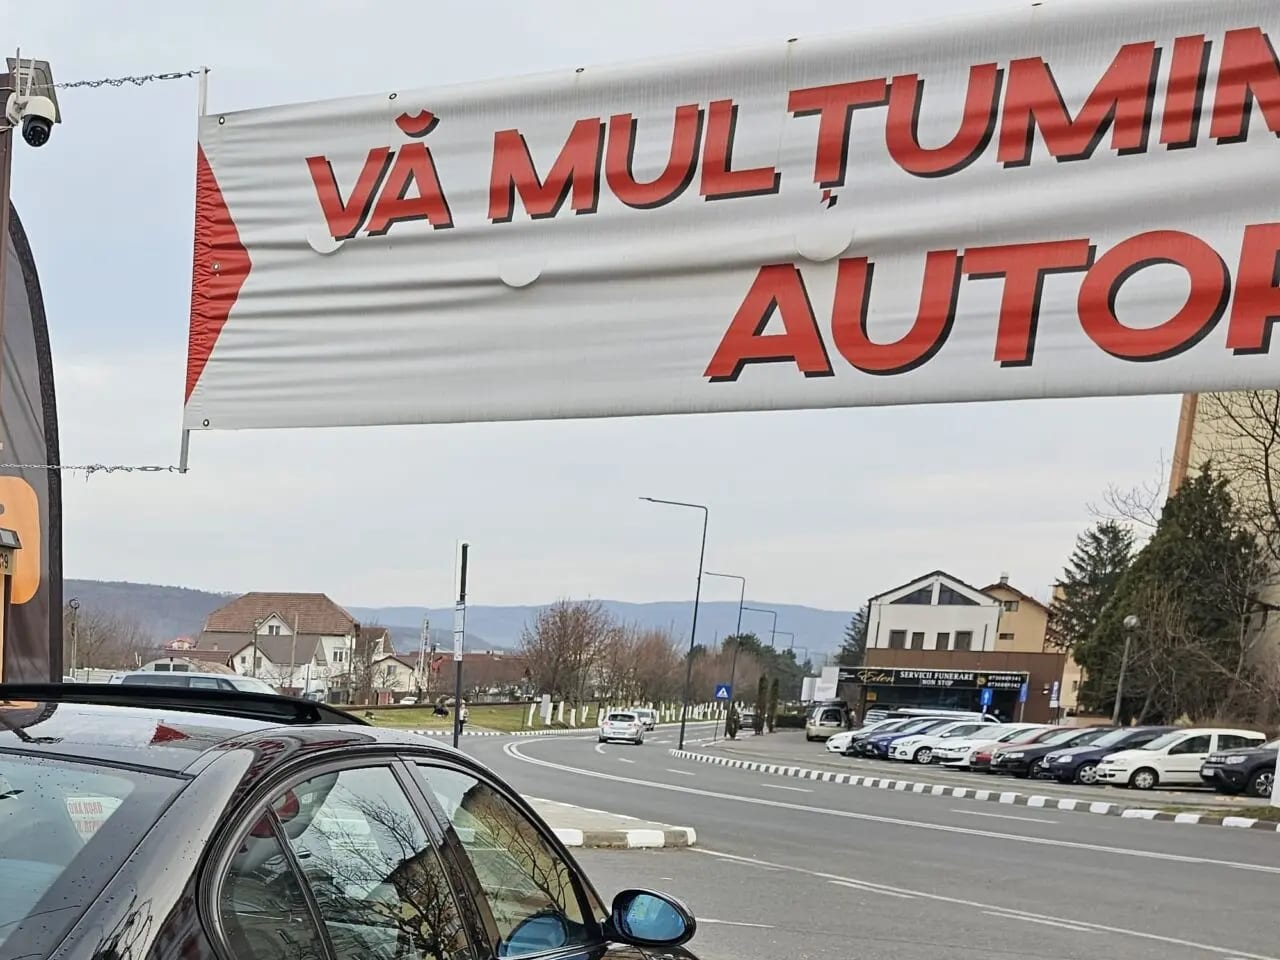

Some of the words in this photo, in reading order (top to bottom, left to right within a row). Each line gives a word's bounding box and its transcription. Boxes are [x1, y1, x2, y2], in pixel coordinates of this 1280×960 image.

[306, 110, 455, 241] VĂ
[900, 671, 932, 679] SERVICII
[934, 672, 974, 681] FUNERARE
